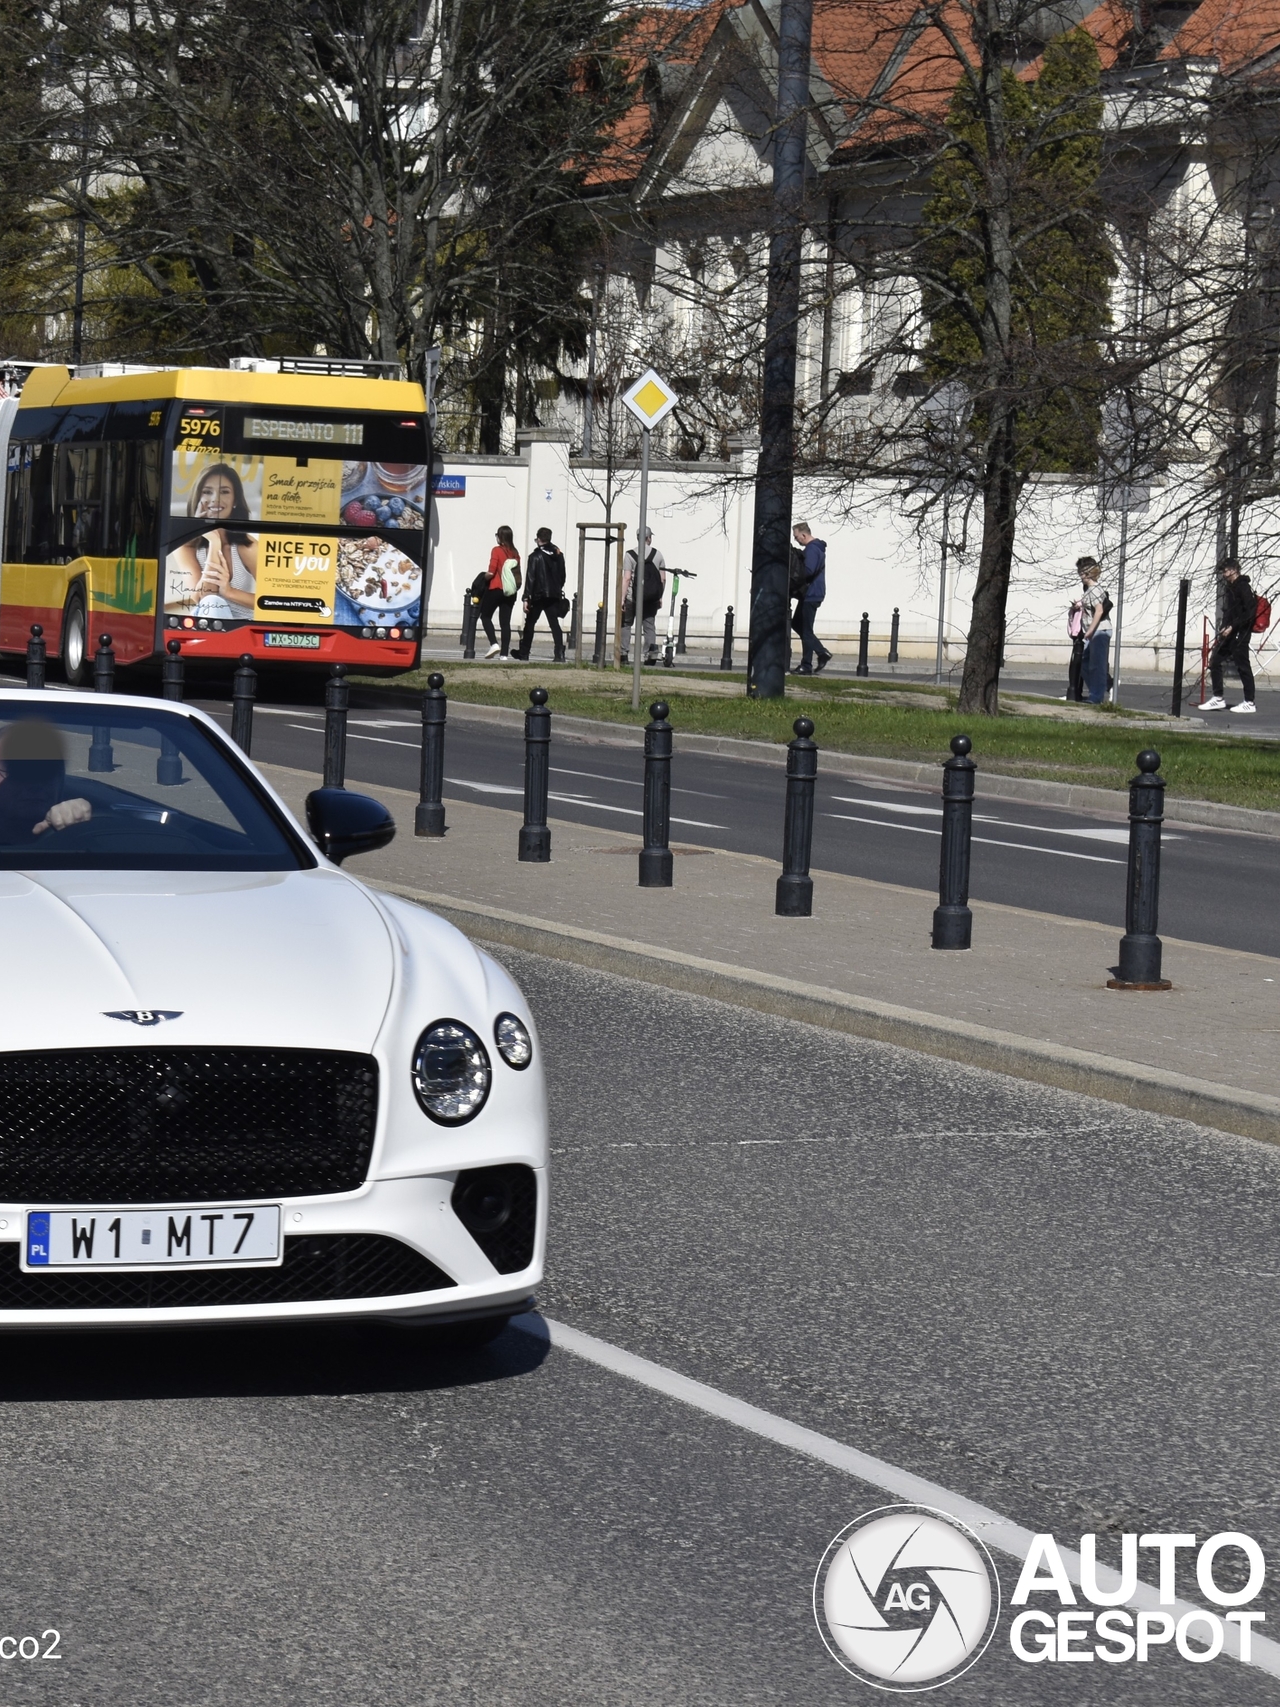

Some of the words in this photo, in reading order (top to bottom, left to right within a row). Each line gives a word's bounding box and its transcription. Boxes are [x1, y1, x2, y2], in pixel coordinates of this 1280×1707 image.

[180, 419, 220, 436] 5976
[252, 419, 334, 440] ESPERANTO
[343, 423, 363, 445] 111
[268, 473, 295, 487] Smak
[295, 478, 336, 492] przejścia
[266, 540, 304, 554] NICE
[309, 543, 331, 556] TO
[265, 555, 293, 568] FIT
[293, 556, 330, 576] you
[170, 579, 219, 595] Klaudia
[271, 633, 283, 644] WX
[287, 634, 317, 646] 5075C
[136, 1011, 154, 1021] B
[71, 1217, 121, 1259] W1
[167, 1213, 255, 1257] MT7
[31, 1245, 47, 1256] PL
